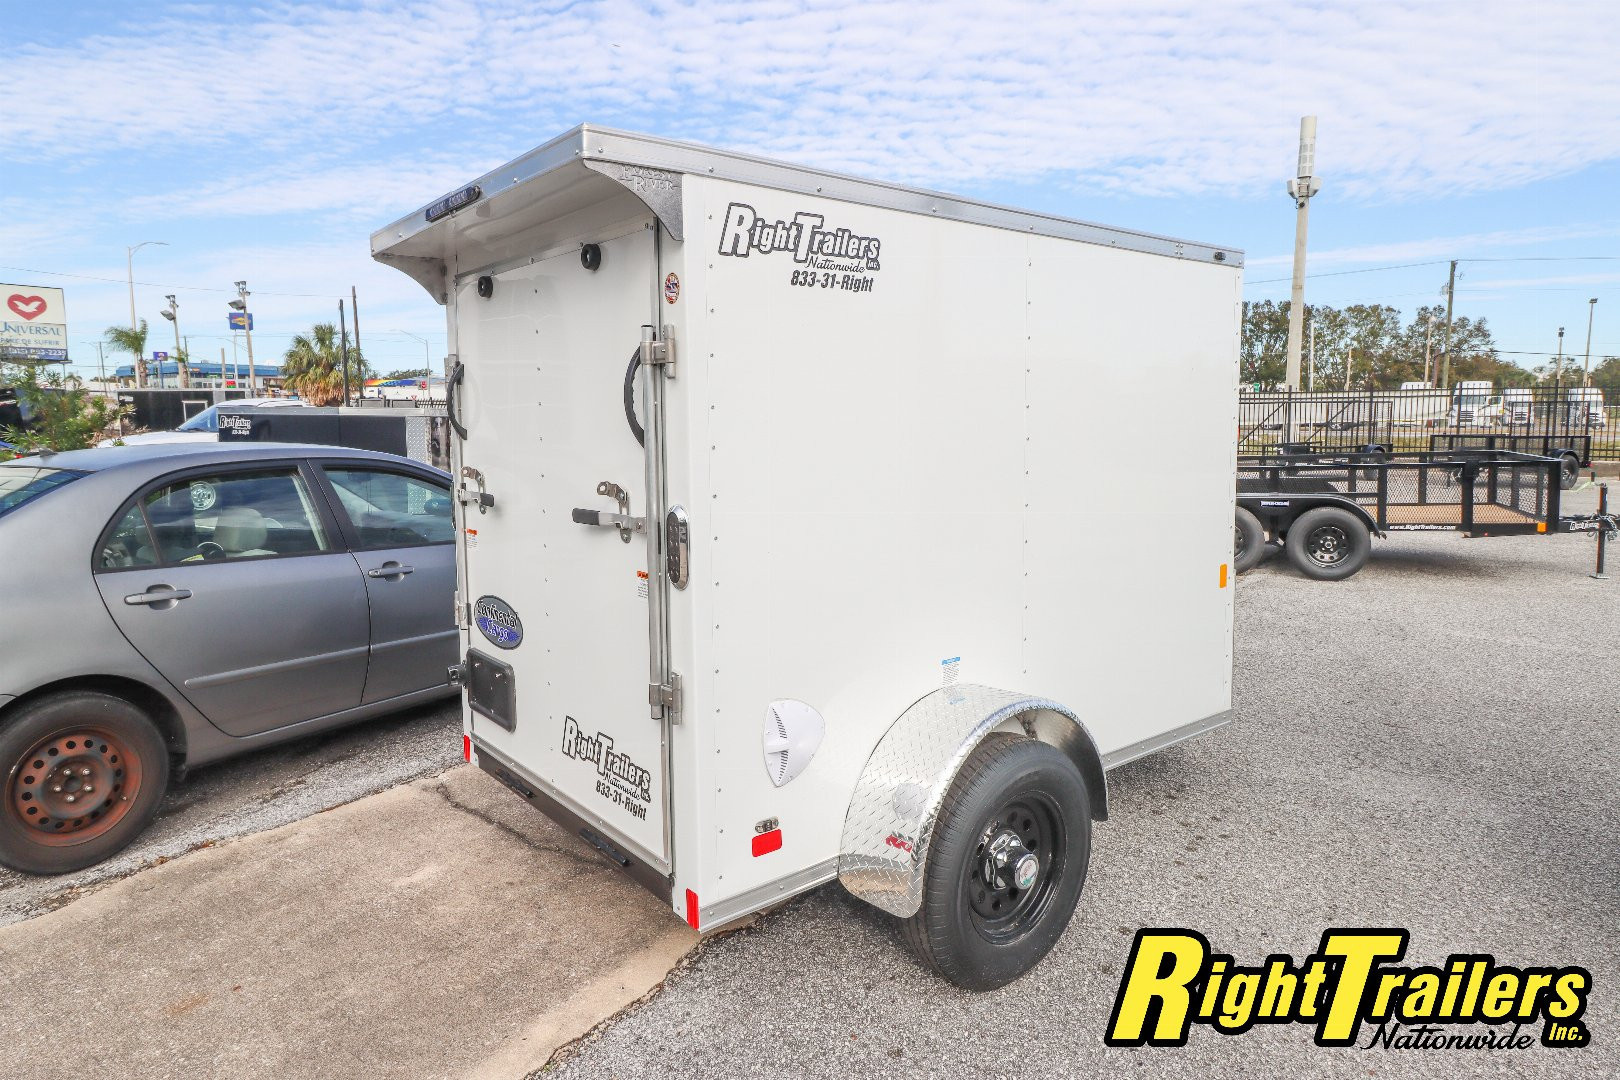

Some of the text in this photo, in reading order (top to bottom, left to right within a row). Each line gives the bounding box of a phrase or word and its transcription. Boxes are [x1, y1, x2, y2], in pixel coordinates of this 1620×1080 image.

[621, 165, 672, 179] FOREST
[632, 177, 674, 192] RIVER
[719, 202, 880, 263] RightTrailers
[805, 255, 865, 273] Nationwide
[791, 270, 874, 293] 833-31-Right
[486, 618, 509, 642] Cargo
[562, 716, 651, 789] RightTrailers
[596, 780, 647, 821] 833-31-Right
